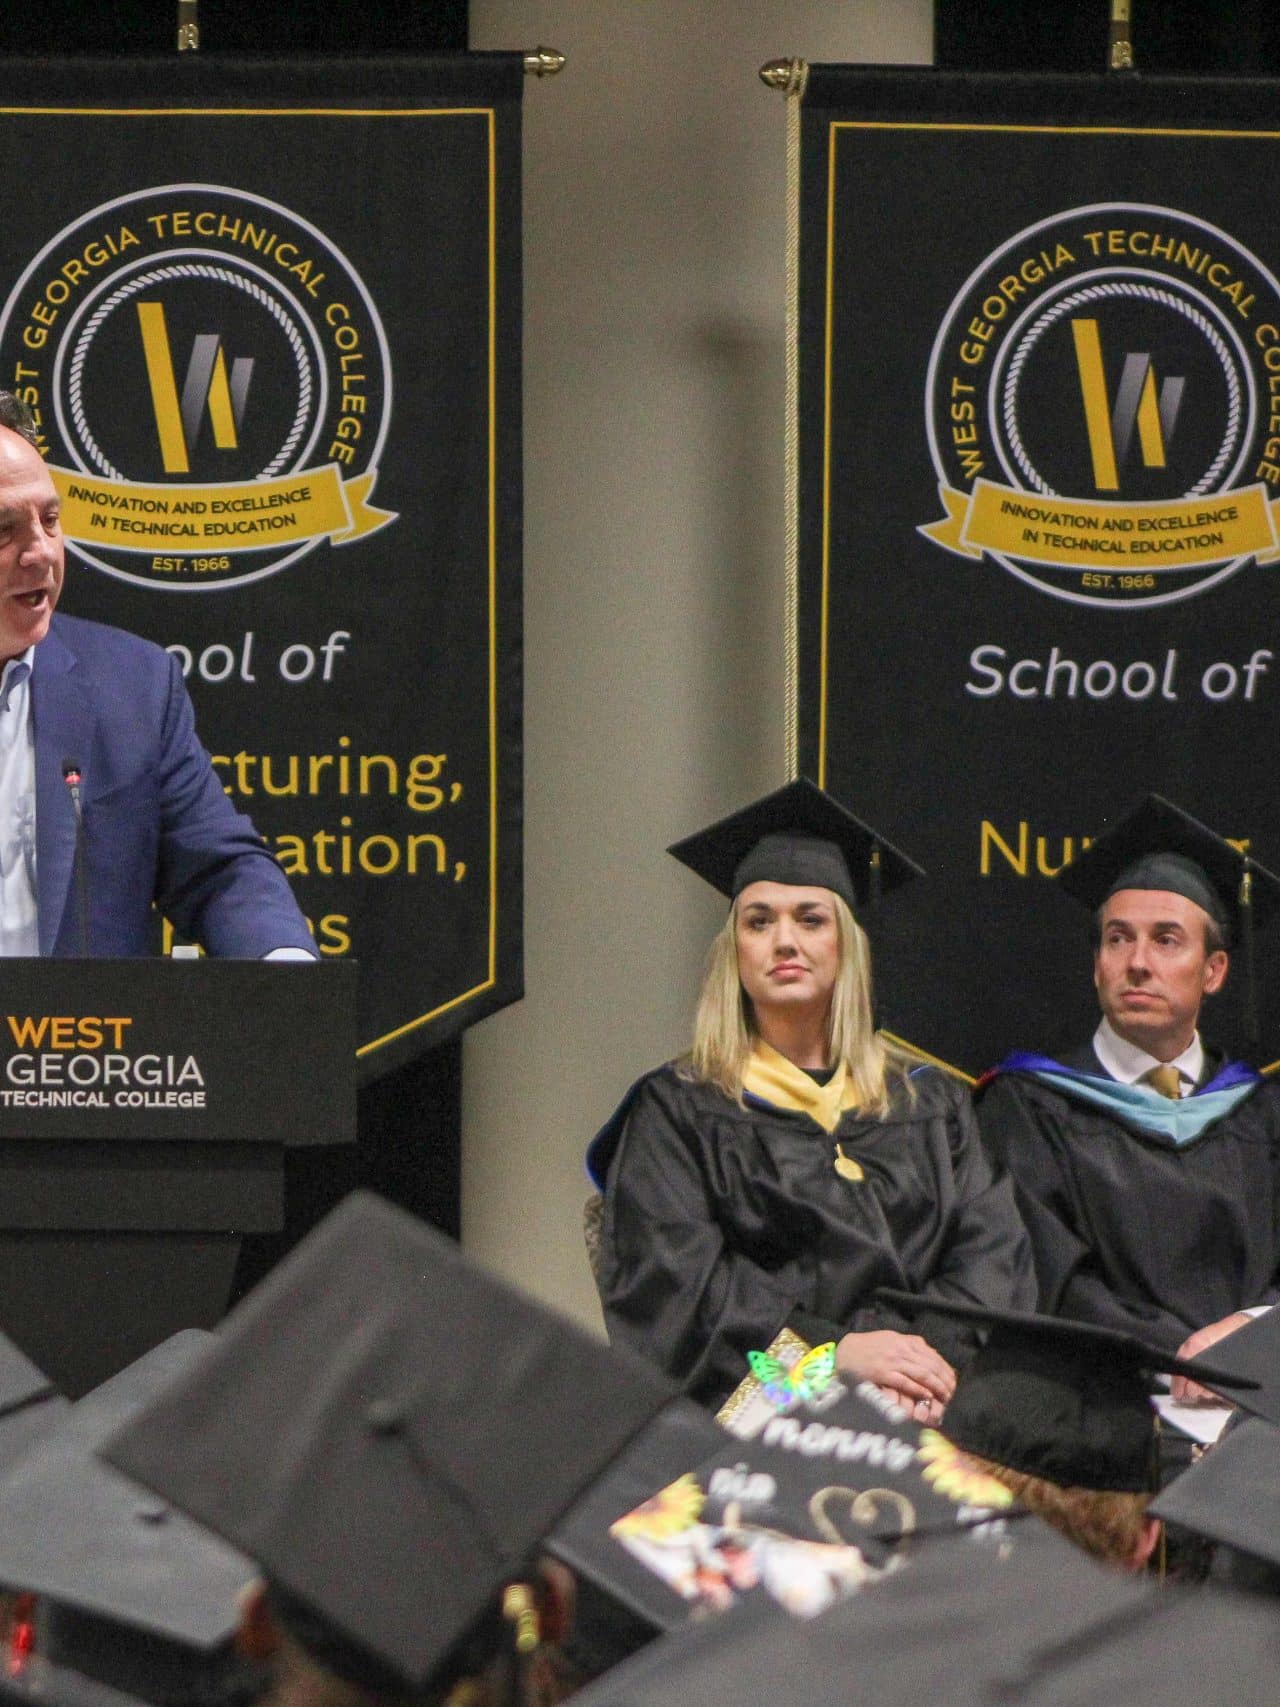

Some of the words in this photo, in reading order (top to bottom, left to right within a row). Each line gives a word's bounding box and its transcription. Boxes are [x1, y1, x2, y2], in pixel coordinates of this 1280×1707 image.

[1083, 230, 1259, 318] TECHNICAL
[960, 244, 1076, 365] GEORGIA
[23, 225, 140, 349] GEORGIA
[147, 211, 326, 298] TECHNICAL
[325, 302, 367, 465] COLLEGE
[952, 377, 984, 478] WEST
[68, 485, 167, 514] INNOVATION
[172, 500, 206, 514] AND
[211, 487, 311, 514] EXCELLENCE
[1000, 501, 1098, 529] INNOVATION
[1103, 517, 1134, 531] AND
[1138, 507, 1238, 531] EXCELLENCE
[90, 513, 106, 528] IN
[110, 518, 199, 536] TECHNICAL
[204, 513, 297, 536] EDUCATION
[1022, 528, 1038, 543] IN
[1042, 533, 1125, 554] TECHNICAL
[1130, 532, 1223, 554] EDUCATION
[152, 557, 188, 571] EST.
[191, 556, 230, 571] 1966
[1081, 573, 1116, 587] EST.
[1119, 574, 1155, 588] 1966
[165, 631, 256, 683] ool
[279, 630, 352, 682] of
[965, 645, 1177, 700] School
[1201, 649, 1273, 699] of
[273, 816, 467, 882] ation,
[7, 1016, 132, 1050] WEST
[6, 1054, 205, 1086] GEORGIA
[0, 1090, 110, 1107] TECHNICAL
[114, 1090, 207, 1108] COLLEGE
